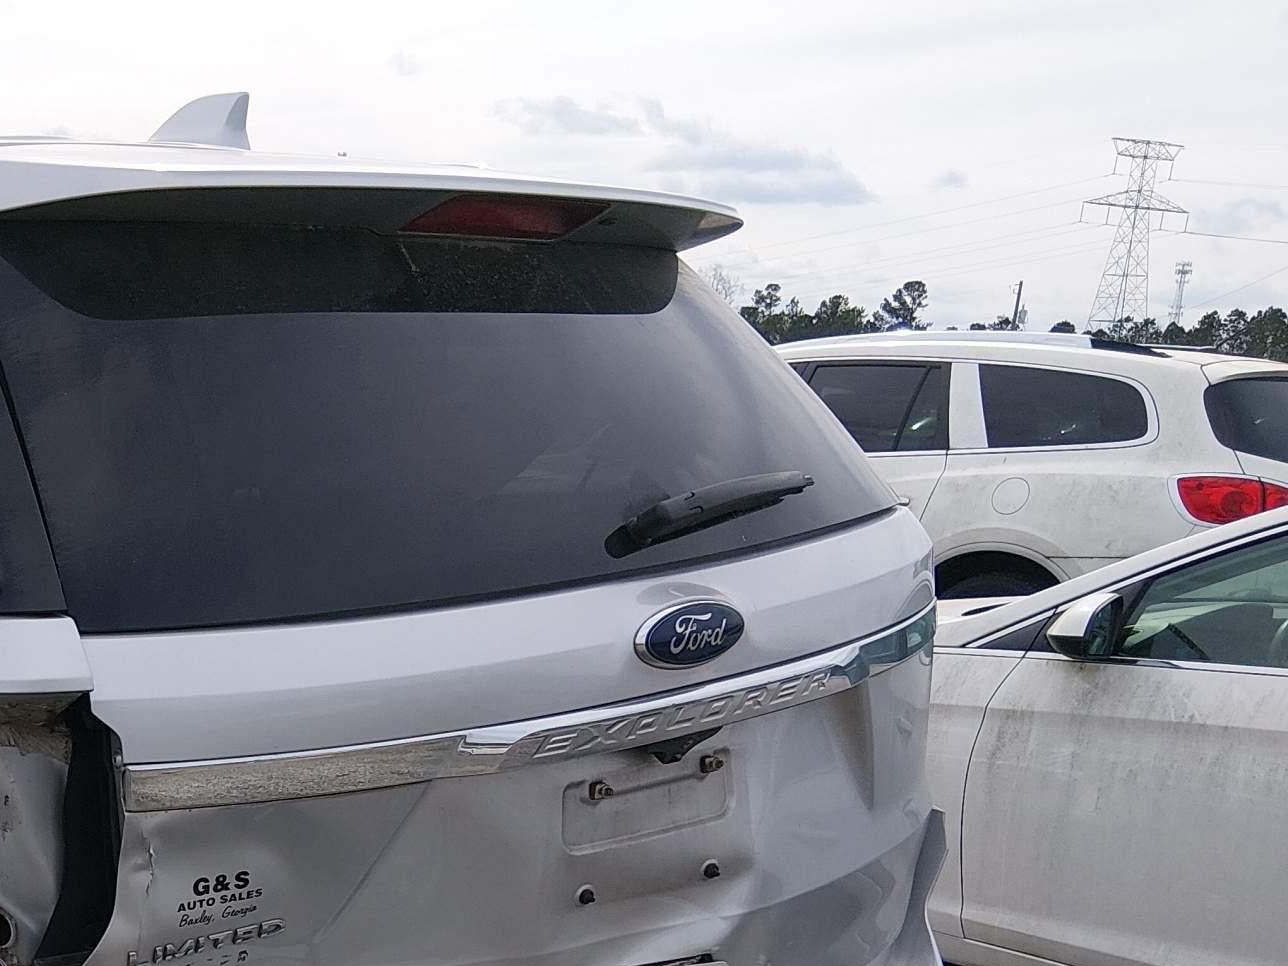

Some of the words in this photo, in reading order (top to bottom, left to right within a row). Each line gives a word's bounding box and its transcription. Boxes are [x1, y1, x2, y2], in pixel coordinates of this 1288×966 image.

[670, 612, 726, 655] Ford
[532, 669, 831, 759] EXPLORER
[193, 870, 250, 897] G&S
[177, 897, 216, 913] AUTO
[220, 889, 263, 905] SALES
[222, 904, 257, 919] Georgia
